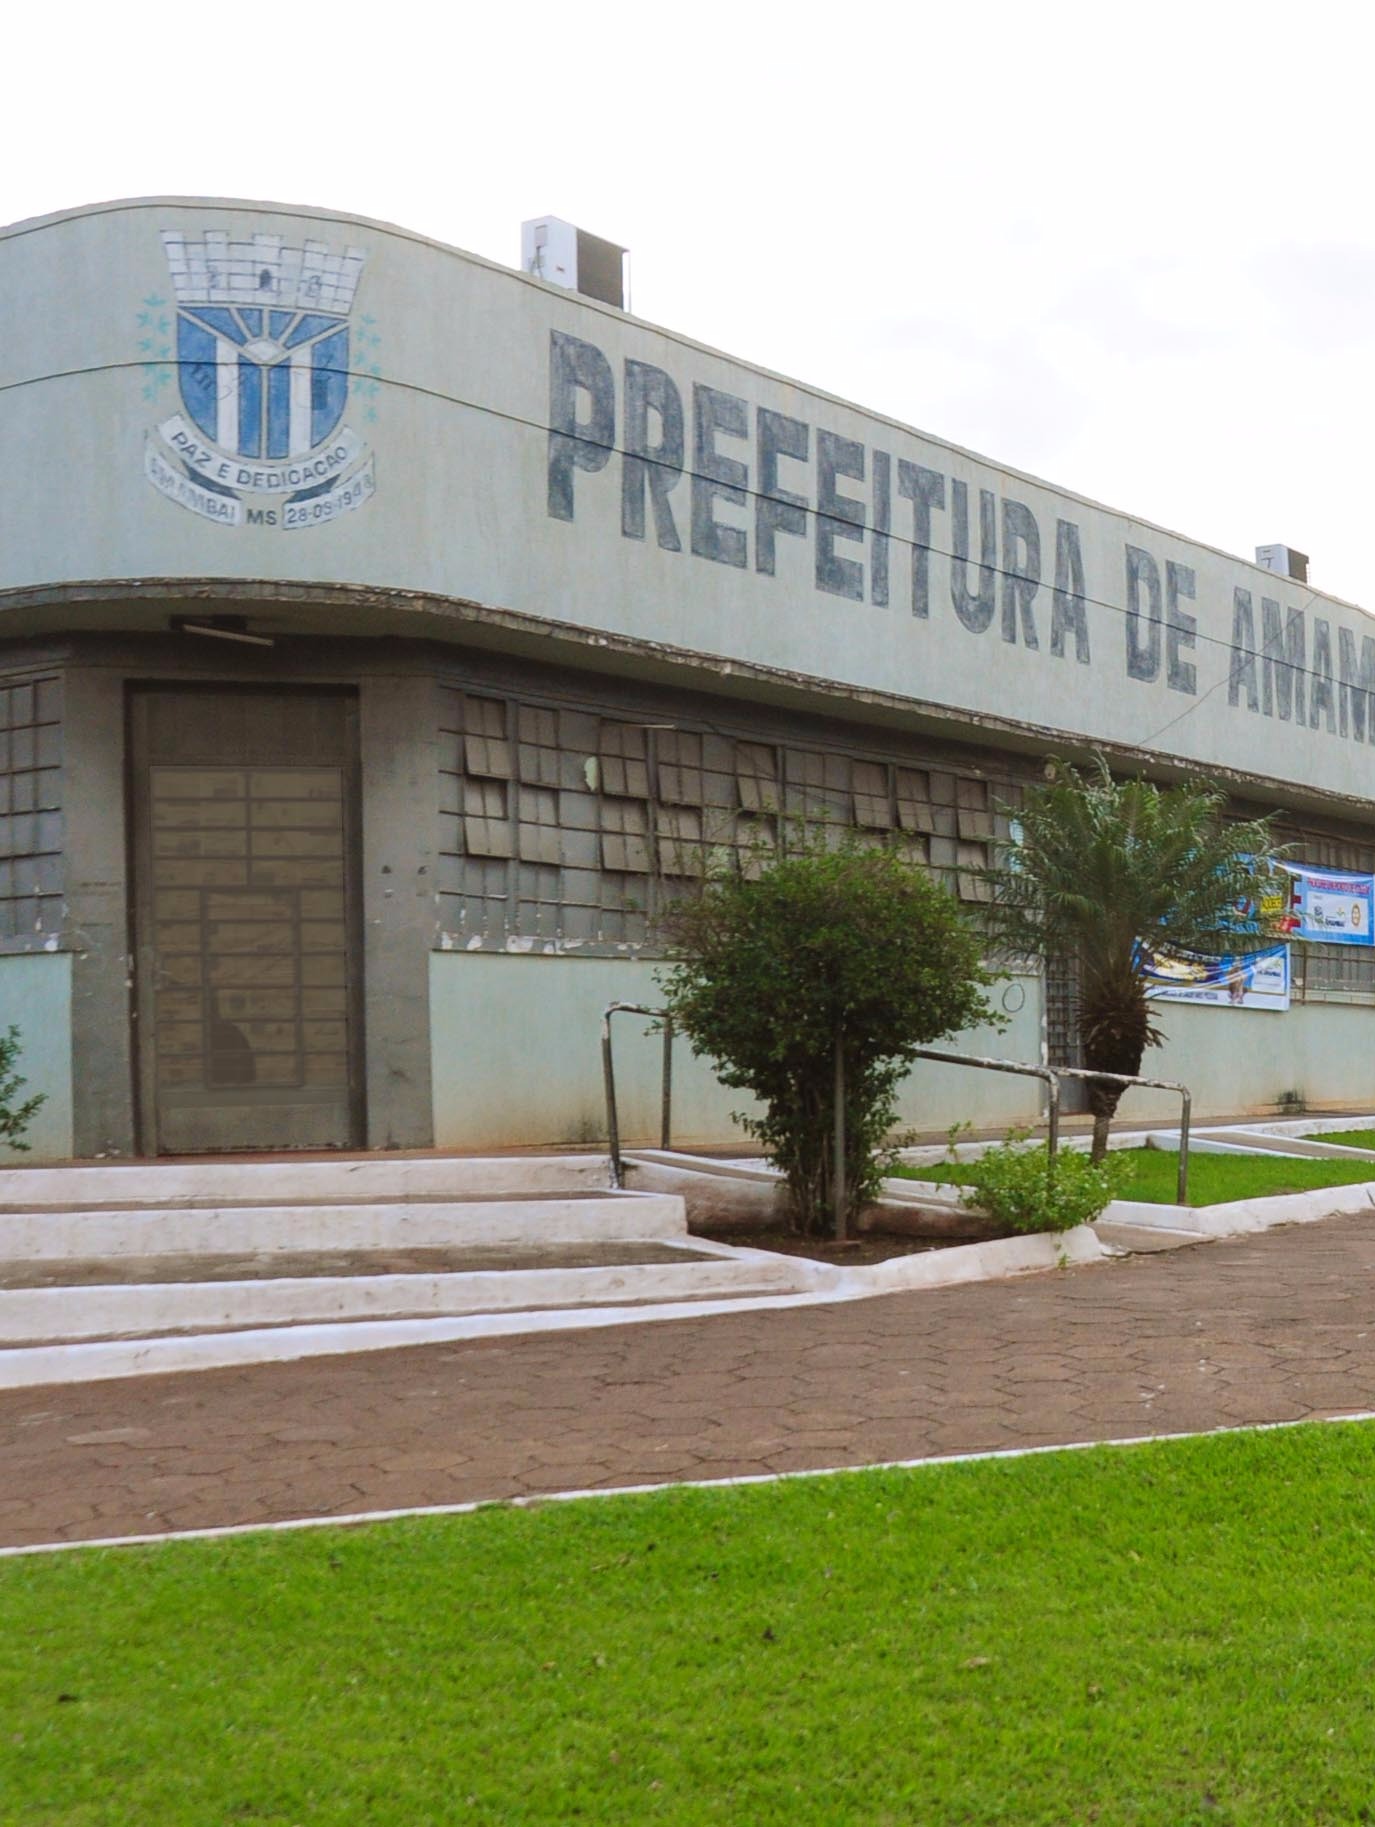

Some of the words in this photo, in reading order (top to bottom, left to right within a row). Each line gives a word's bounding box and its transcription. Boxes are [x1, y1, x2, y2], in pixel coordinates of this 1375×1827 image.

[171, 431, 213, 469] PAZ
[217, 462, 231, 479] E
[247, 508, 277, 526] MS
[547, 328, 1091, 665] PREFEITURA
[1125, 543, 1198, 696] DE
